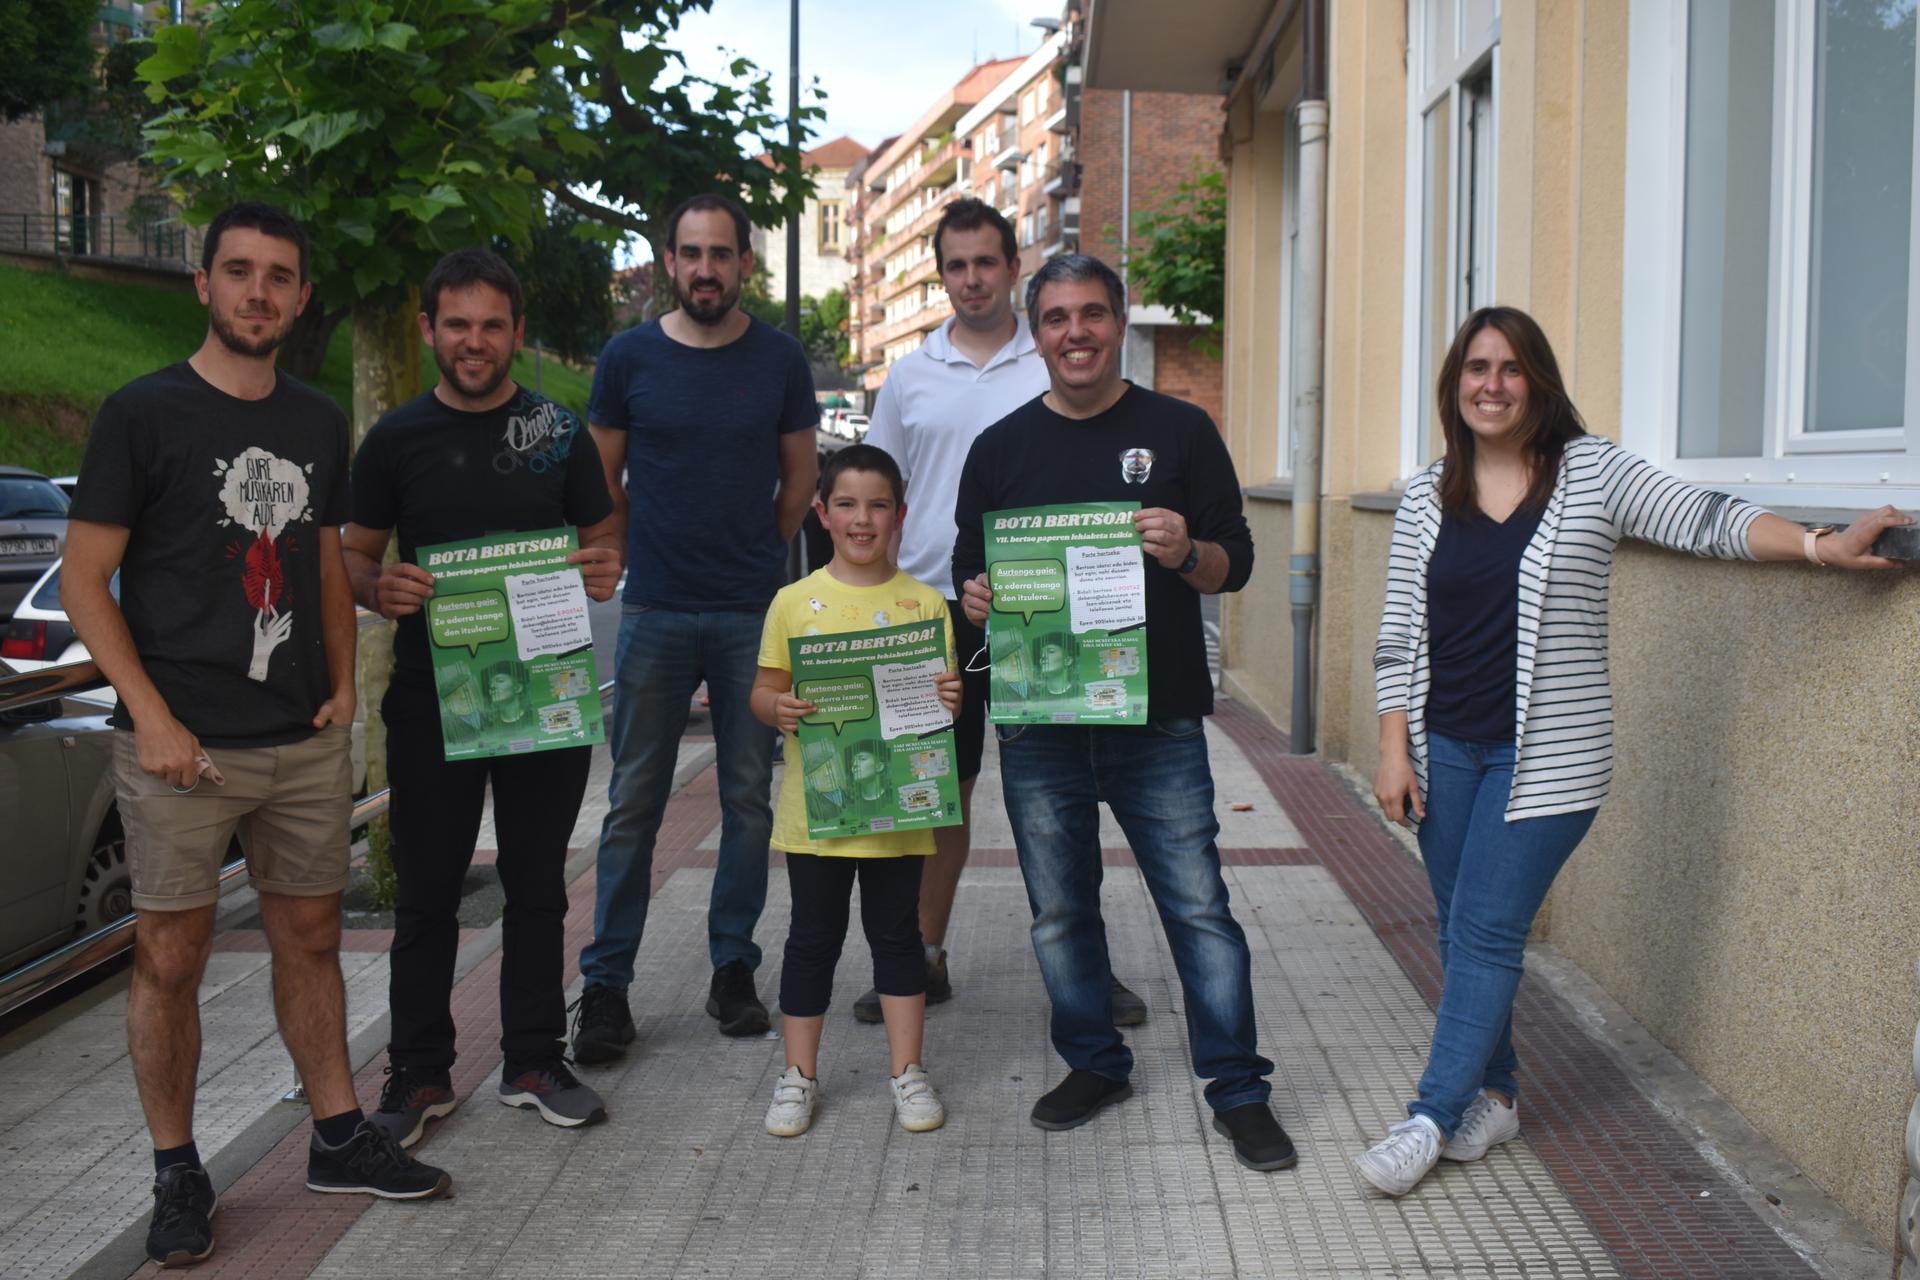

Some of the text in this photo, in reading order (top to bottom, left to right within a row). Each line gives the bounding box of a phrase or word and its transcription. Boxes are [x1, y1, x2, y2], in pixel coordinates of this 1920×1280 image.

[246, 458, 272, 480] GURE
[239, 481, 294, 503] MUSIKAREN
[253, 503, 276, 526] ALDE
[994, 511, 1133, 530] BOTA BERTSOA!
[1036, 535, 1070, 543] paperen
[429, 534, 569, 566] BOTA BERTSOA!
[446, 568, 474, 577] bertso
[474, 564, 508, 575] paperen
[547, 556, 567, 564] txiki
[997, 567, 1057, 577] Aurtengo gaia:
[437, 598, 498, 612] Aurtengo gaia:
[444, 628, 460, 636] den
[800, 626, 936, 654] BOTA BERTSOA!
[842, 655, 876, 664] paperen
[805, 681, 865, 694] Aurtengo gaia:
